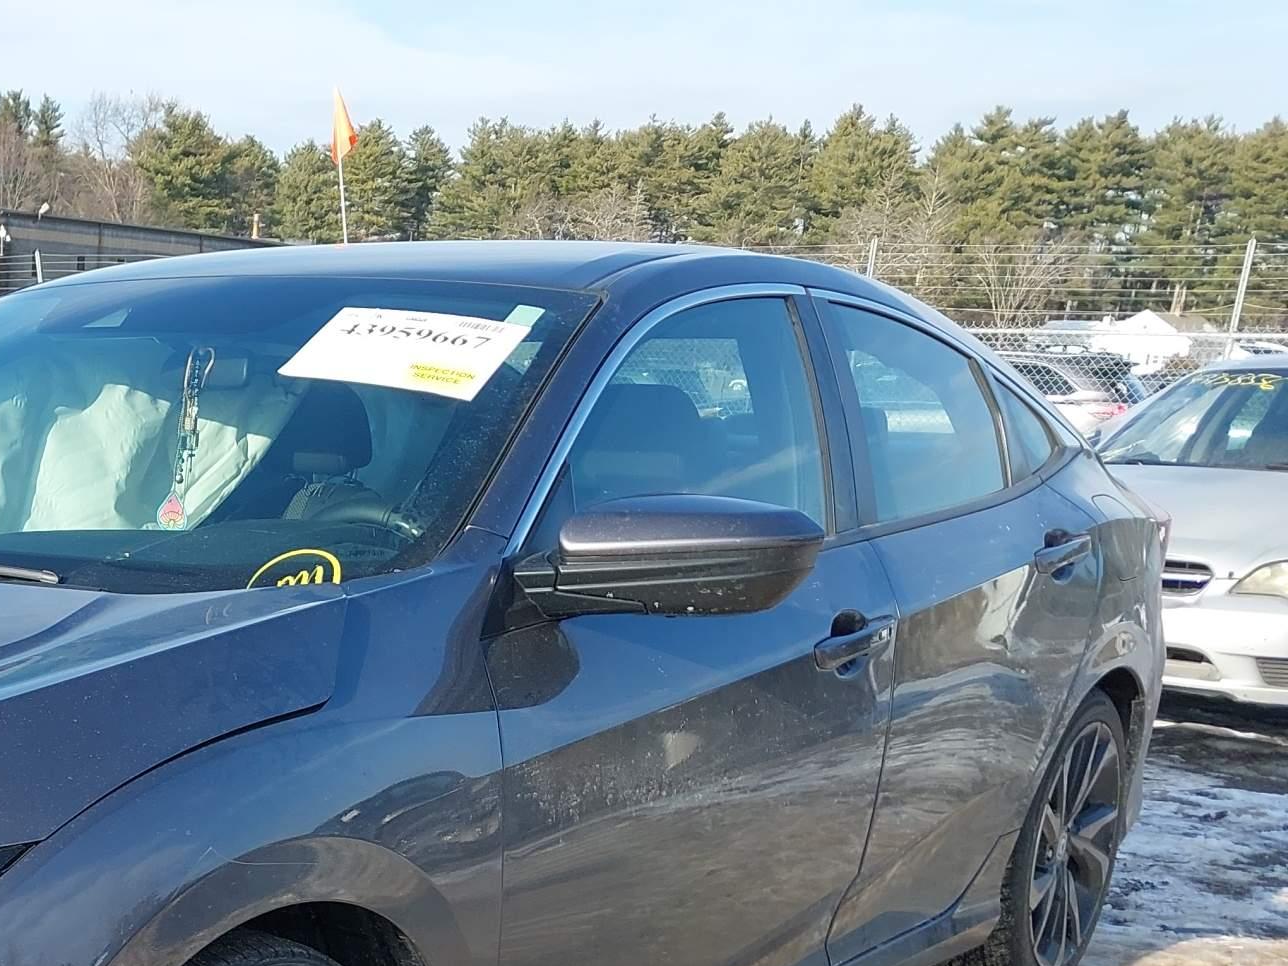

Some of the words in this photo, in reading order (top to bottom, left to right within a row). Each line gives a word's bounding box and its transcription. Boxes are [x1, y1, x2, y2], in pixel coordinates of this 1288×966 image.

[340, 322, 492, 349] 43959667
[409, 363, 476, 380] INSPECTION
[412, 372, 461, 385] SERVICE
